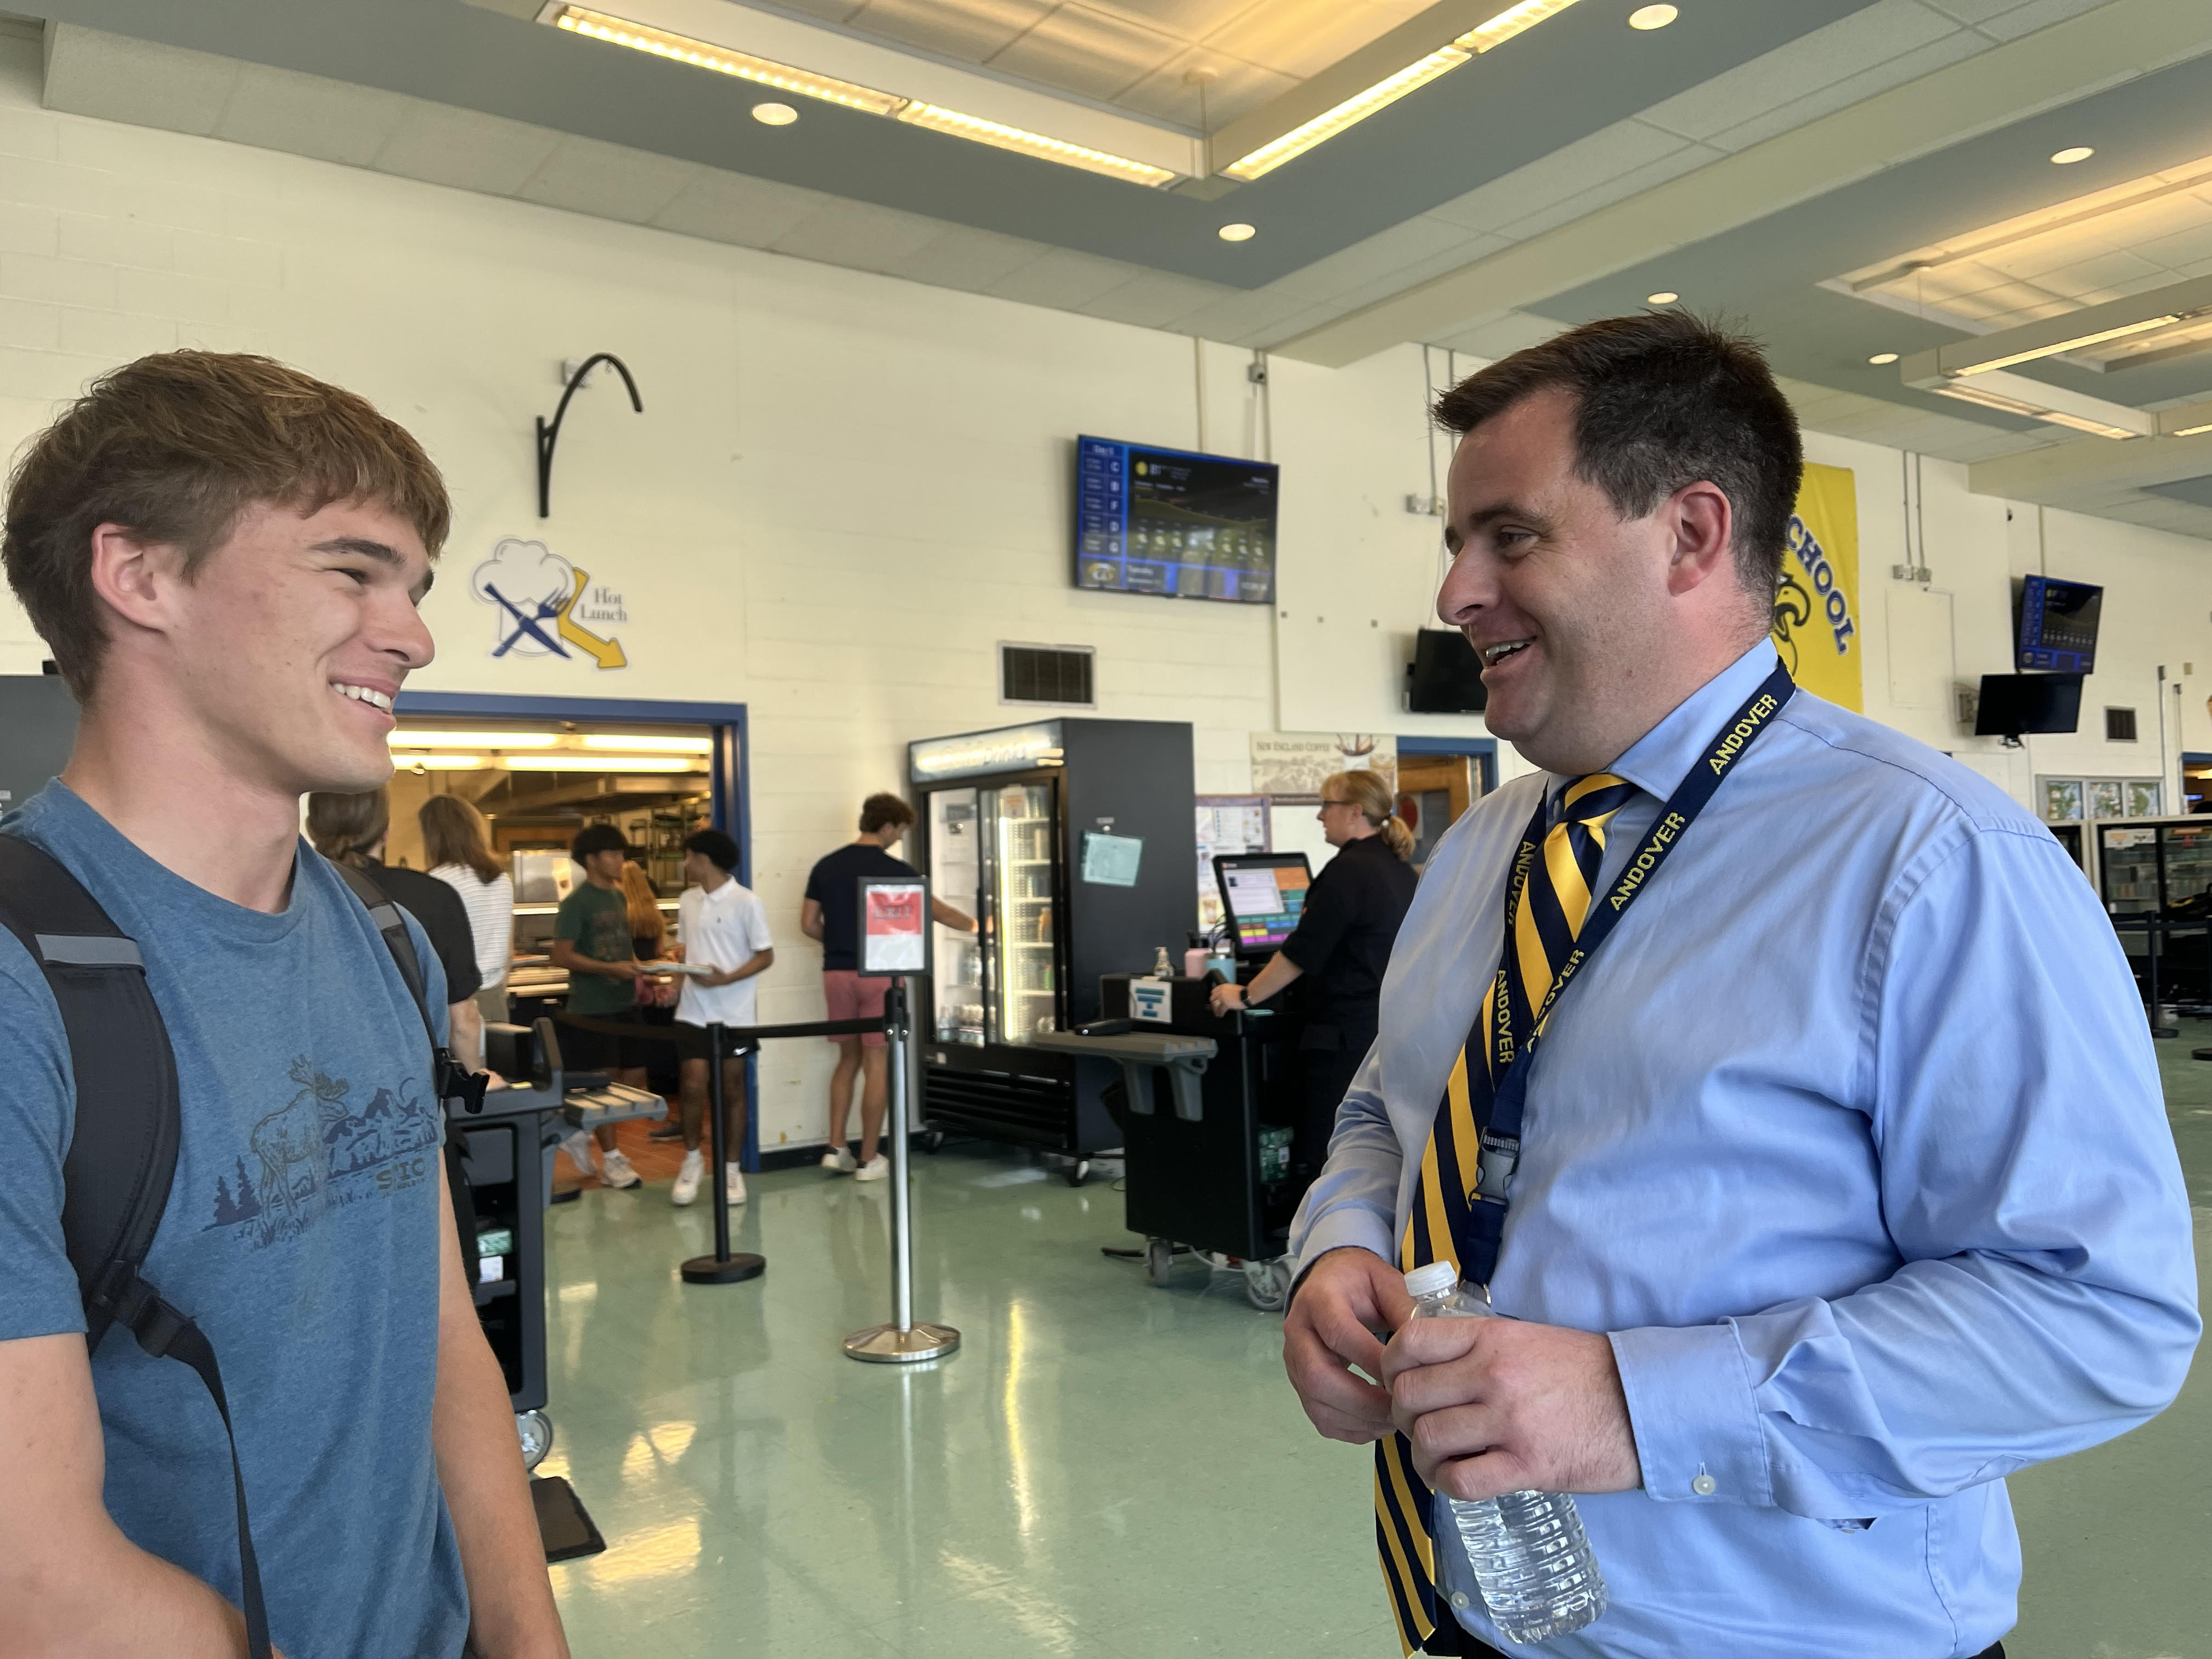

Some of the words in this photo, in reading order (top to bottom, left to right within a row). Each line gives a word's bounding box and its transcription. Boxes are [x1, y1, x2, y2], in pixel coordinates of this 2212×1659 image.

[580, 603, 628, 622] Lunch
[594, 588, 623, 604] Hot
[1787, 516, 1854, 656] CHOOL
[1709, 694, 1778, 776] ANDOVER
[1610, 812, 1685, 911] ANDOVER
[1498, 969, 1515, 1063] ANDOVER
